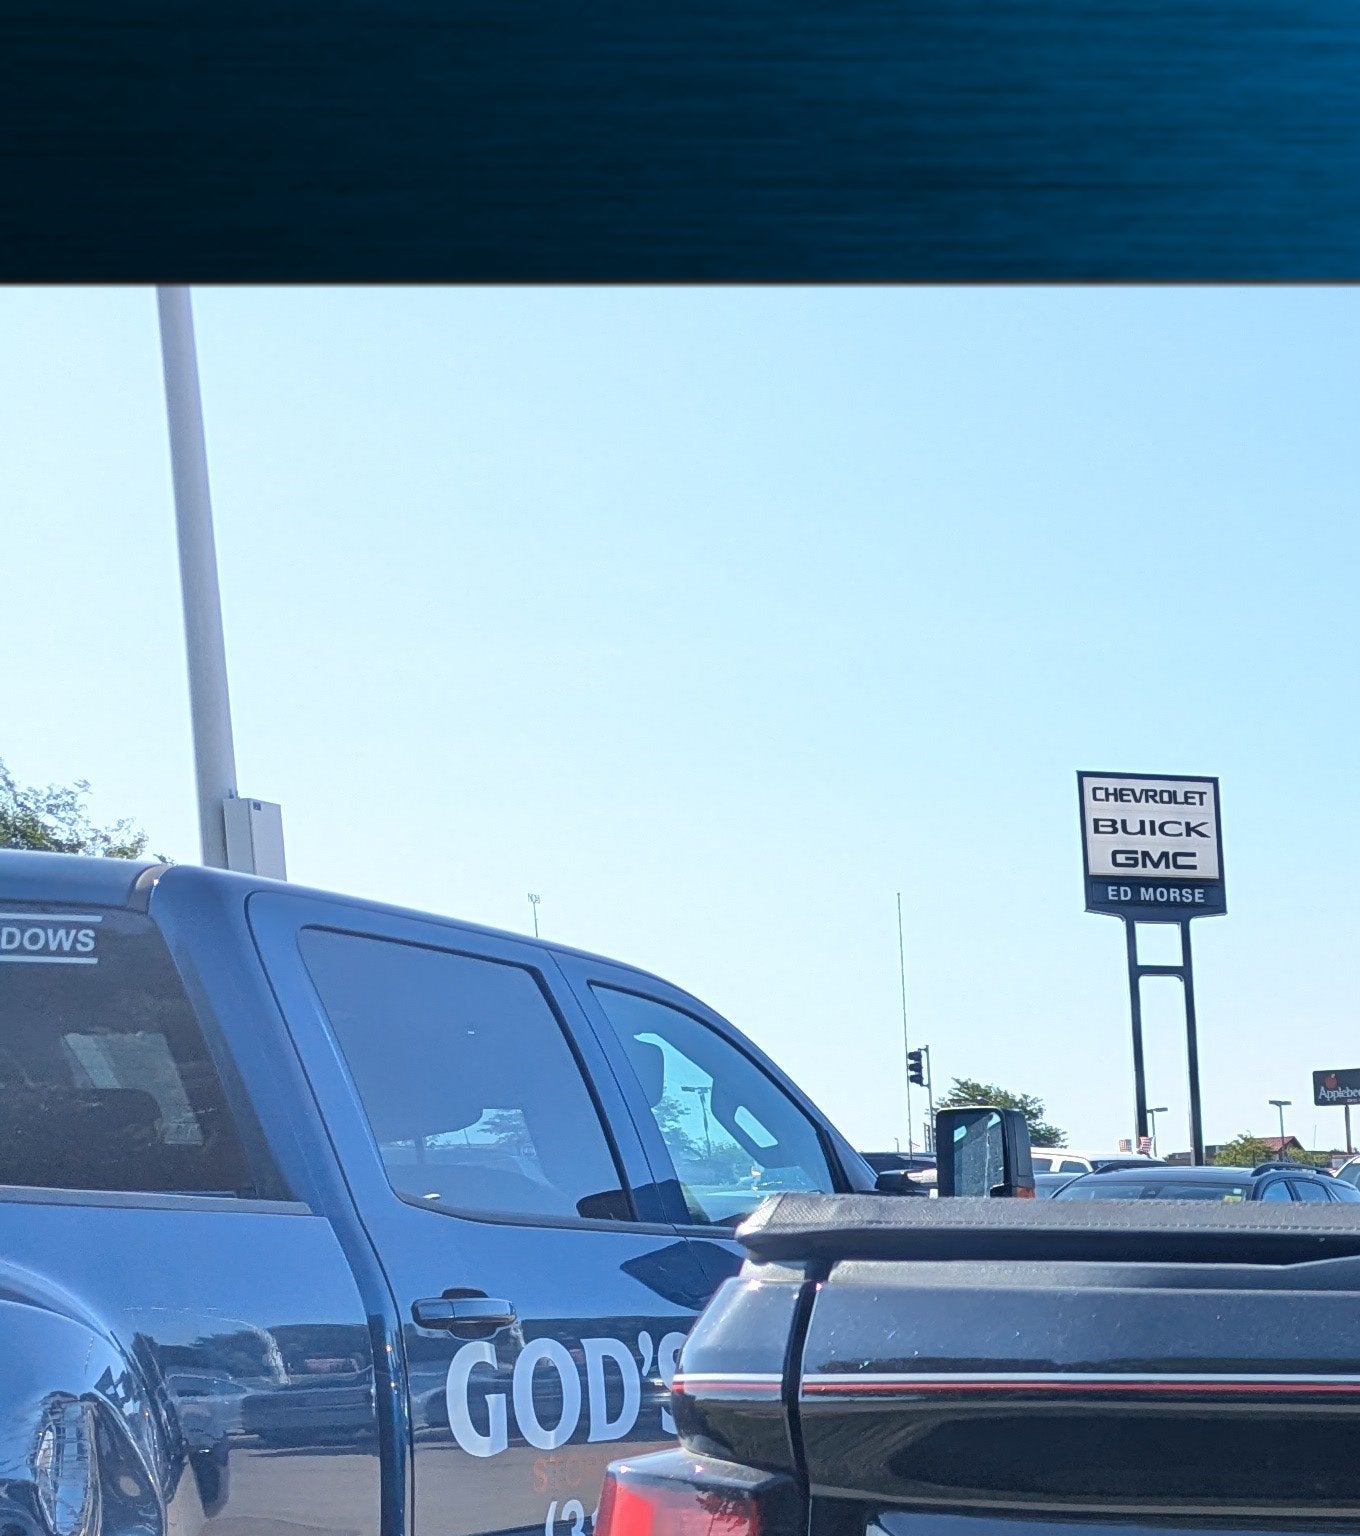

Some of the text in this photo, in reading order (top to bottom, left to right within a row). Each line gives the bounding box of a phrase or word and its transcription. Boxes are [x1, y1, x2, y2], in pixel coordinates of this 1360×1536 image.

[1092, 786, 1208, 806] CHEVROLET
[1092, 817, 1211, 839] BUICK
[1111, 849, 1198, 870] GMC
[1107, 886, 1205, 903] ED MORSE
